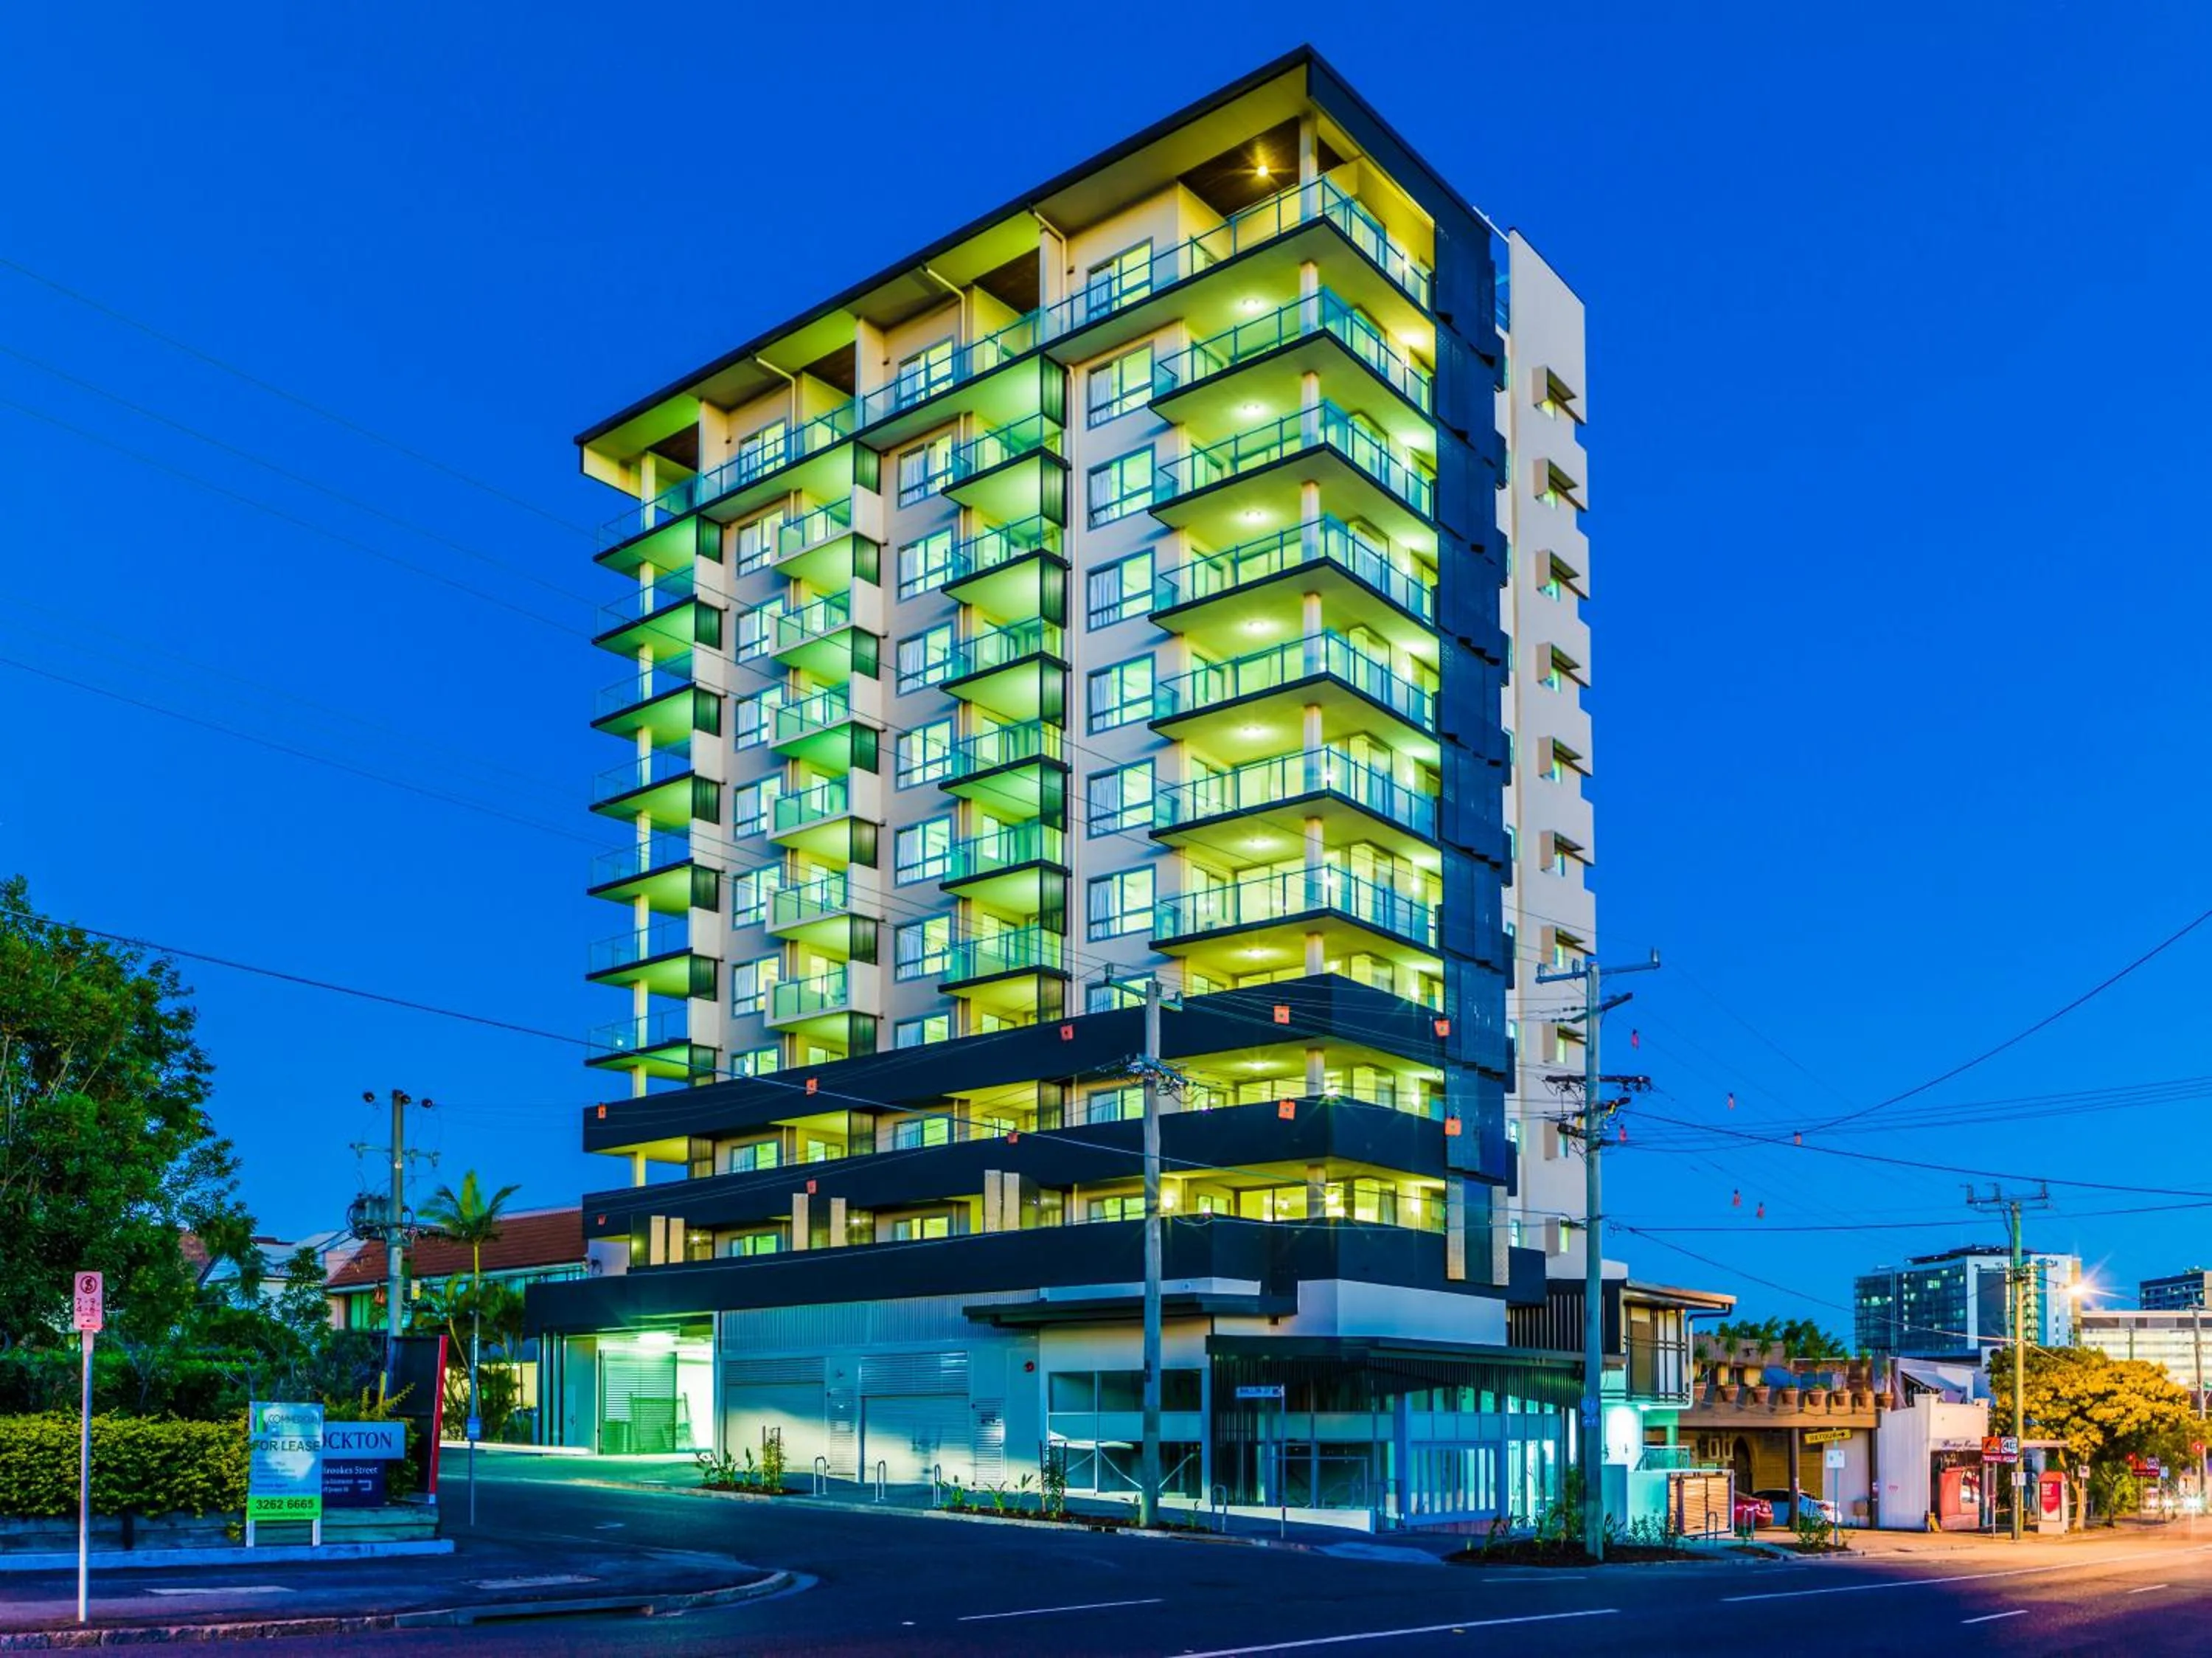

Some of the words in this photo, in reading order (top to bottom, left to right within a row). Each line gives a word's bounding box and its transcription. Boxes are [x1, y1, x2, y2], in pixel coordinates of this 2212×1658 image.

[281, 1440, 321, 1451] LEASE
[355, 1465, 378, 1474] Street
[255, 1499, 284, 1510] 3262
